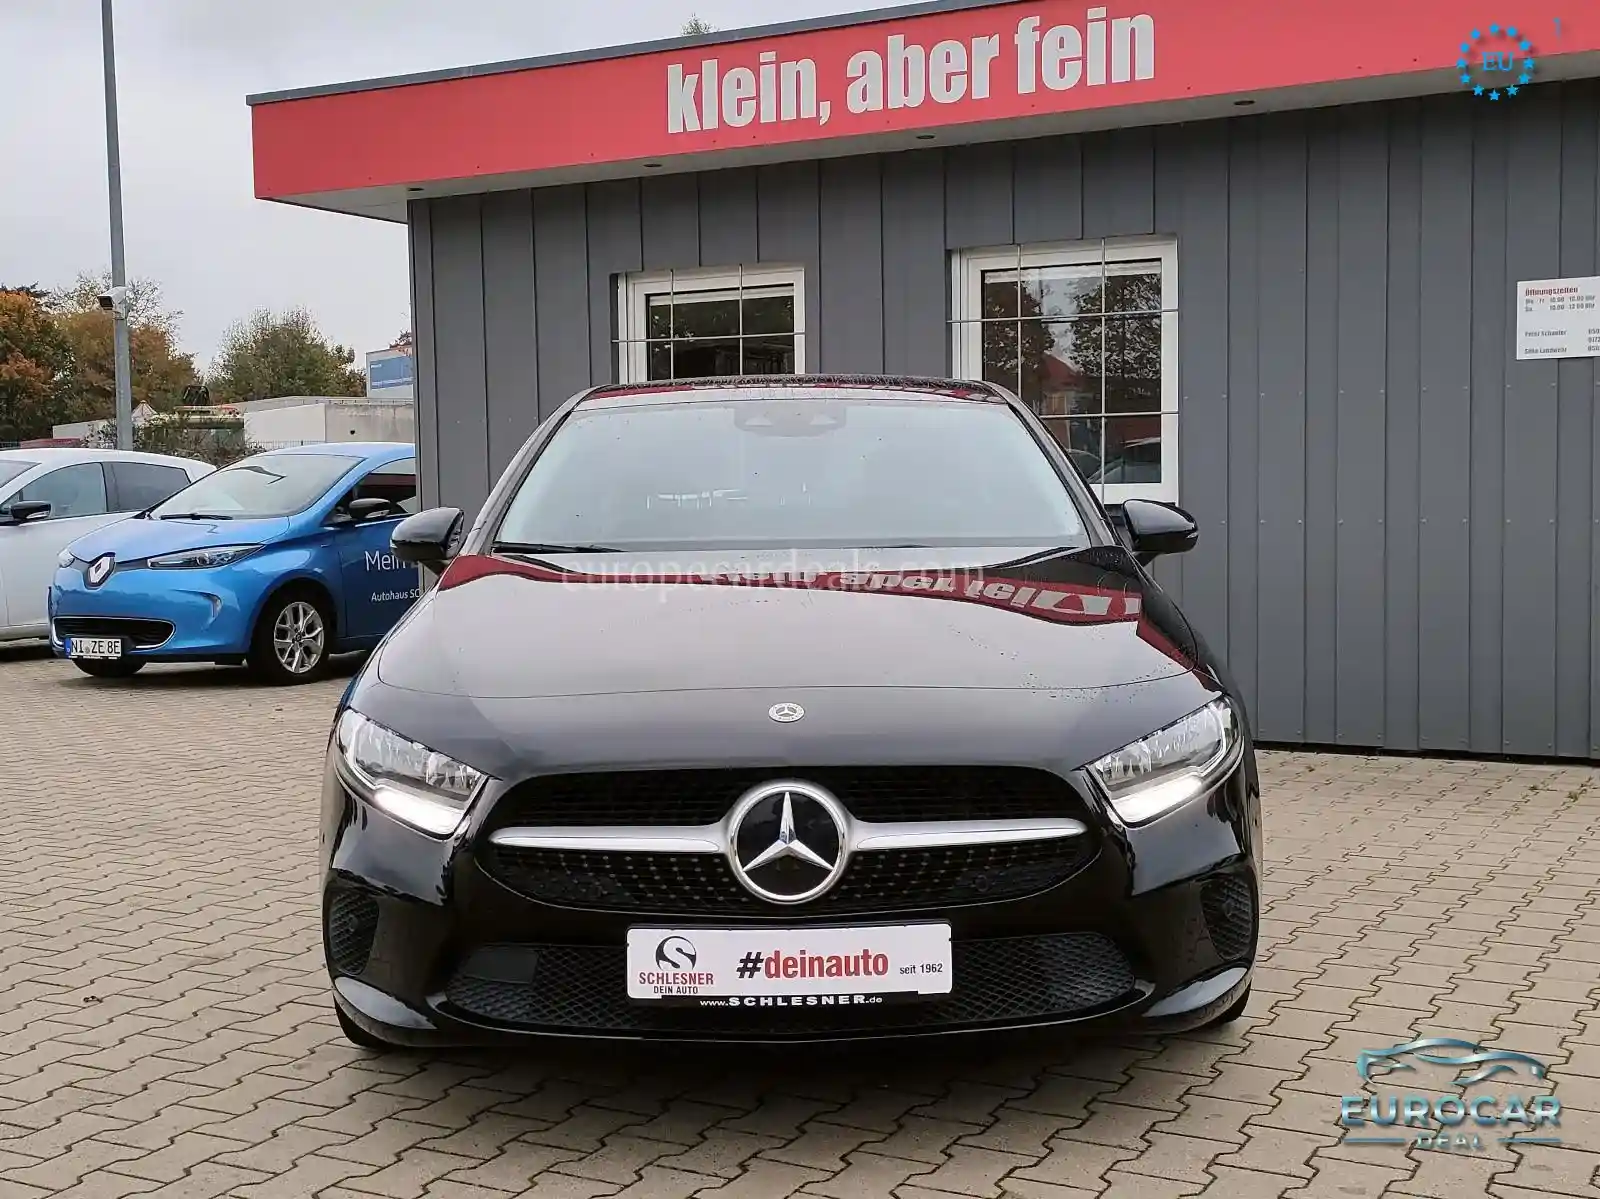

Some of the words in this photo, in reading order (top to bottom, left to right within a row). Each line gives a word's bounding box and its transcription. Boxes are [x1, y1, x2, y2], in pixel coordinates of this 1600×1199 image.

[667, 51, 831, 134] klein,
[846, 32, 999, 113] aber
[1014, 7, 1154, 95] fein
[371, 590, 409, 602] Autohaus
[71, 639, 84, 654] NI
[91, 640, 105, 654] ZE
[107, 640, 121, 655] 8E
[736, 948, 889, 979] #deinauto
[899, 965, 917, 975] seit
[919, 963, 943, 974] 1962
[639, 971, 714, 986] SCHLESNER
[653, 985, 673, 994] DEIN
[676, 985, 699, 995] AUTO
[700, 994, 883, 1007] www.SCHLESNER.de
